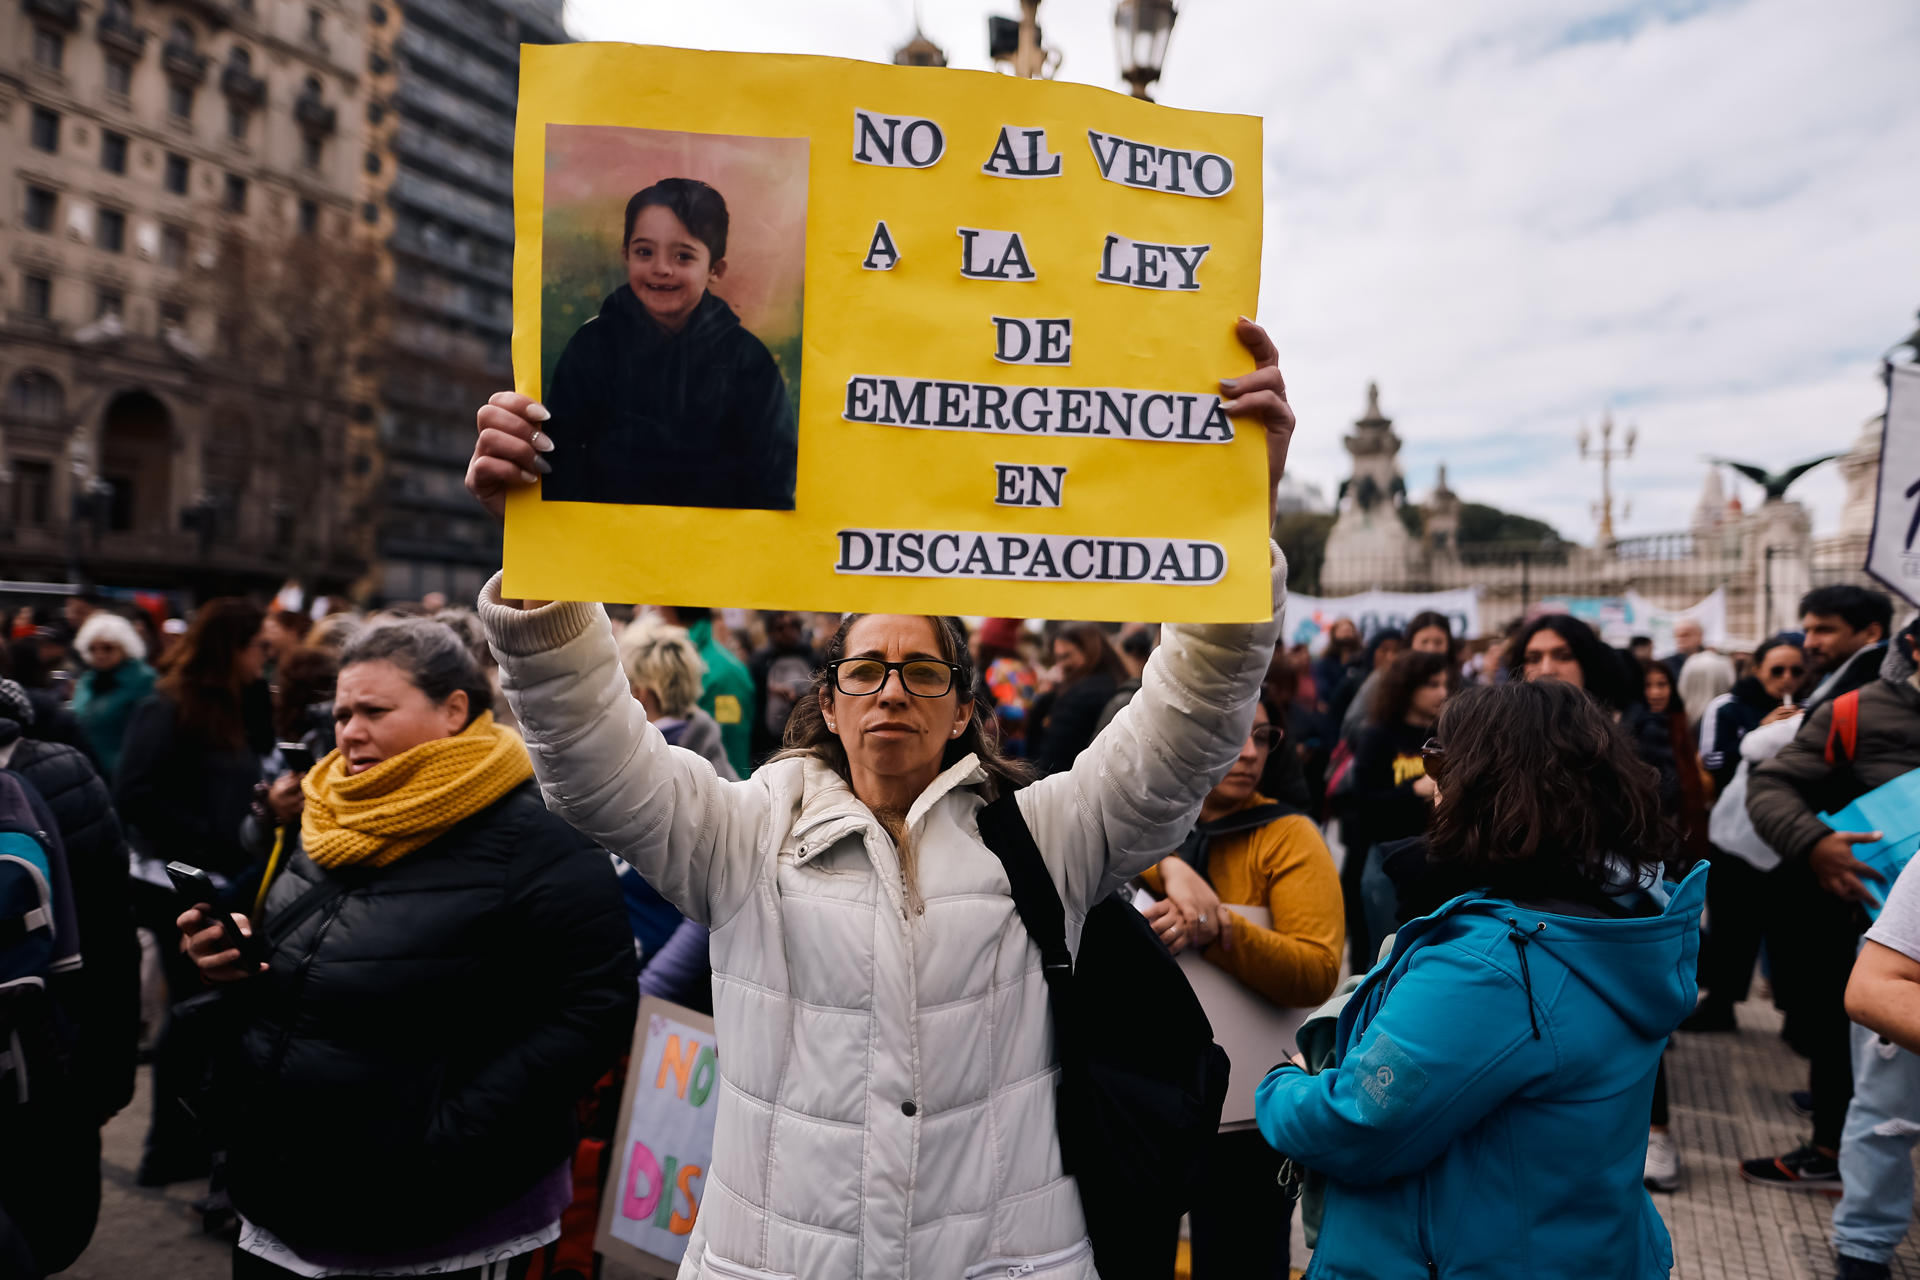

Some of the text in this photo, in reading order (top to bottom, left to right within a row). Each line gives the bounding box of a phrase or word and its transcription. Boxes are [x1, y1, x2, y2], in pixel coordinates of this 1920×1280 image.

[855, 112, 1233, 196] NO AL VETO
[863, 221, 1210, 289] A LA LEY
[994, 317, 1070, 363] DE
[843, 377, 1234, 442] EMERGENCIA
[995, 464, 1067, 506] EN
[835, 530, 1225, 582] DISCAPACIDAD
[655, 1033, 716, 1108] NO
